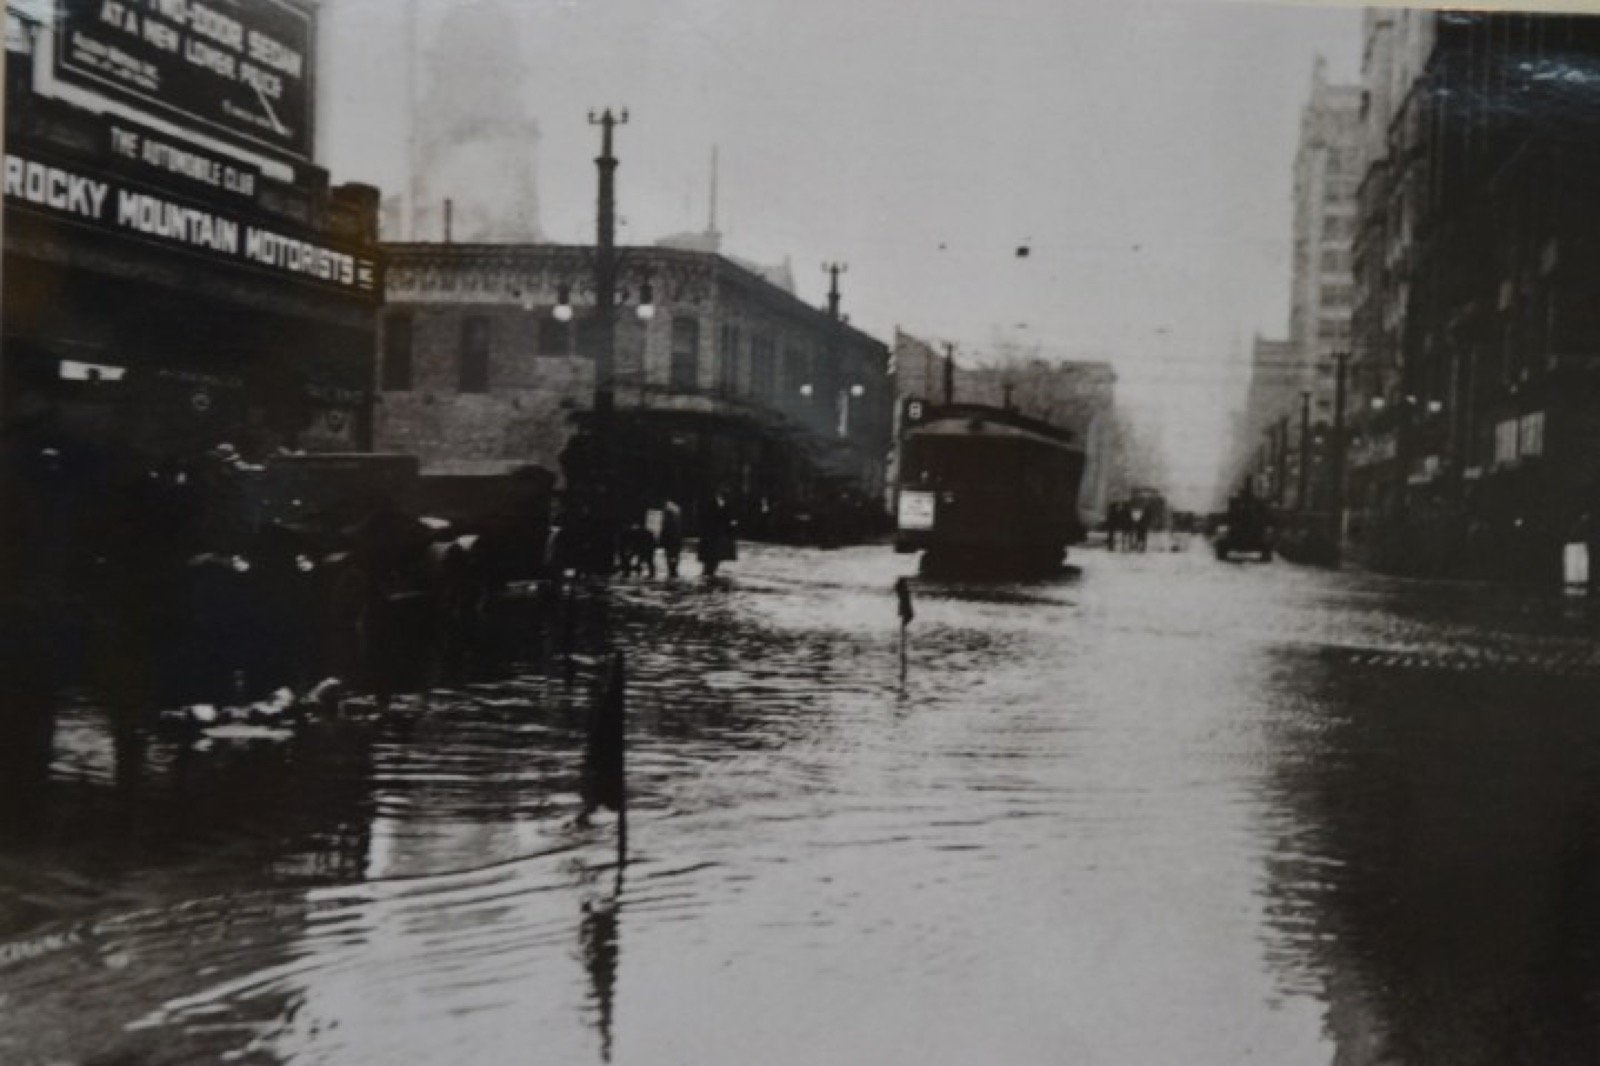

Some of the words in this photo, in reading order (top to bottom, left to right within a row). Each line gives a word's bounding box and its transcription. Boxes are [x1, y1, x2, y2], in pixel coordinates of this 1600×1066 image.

[124, 11, 138, 35] A
[143, 17, 179, 52] NEW
[184, 37, 235, 79] LOWER
[111, 126, 138, 157] THE
[142, 139, 221, 185] AUTOMOBILE
[224, 166, 254, 196] CLUB
[4, 154, 107, 218] ROCKY
[118, 190, 238, 253] MOUNTAIN
[246, 225, 354, 284] MOTORISTS
